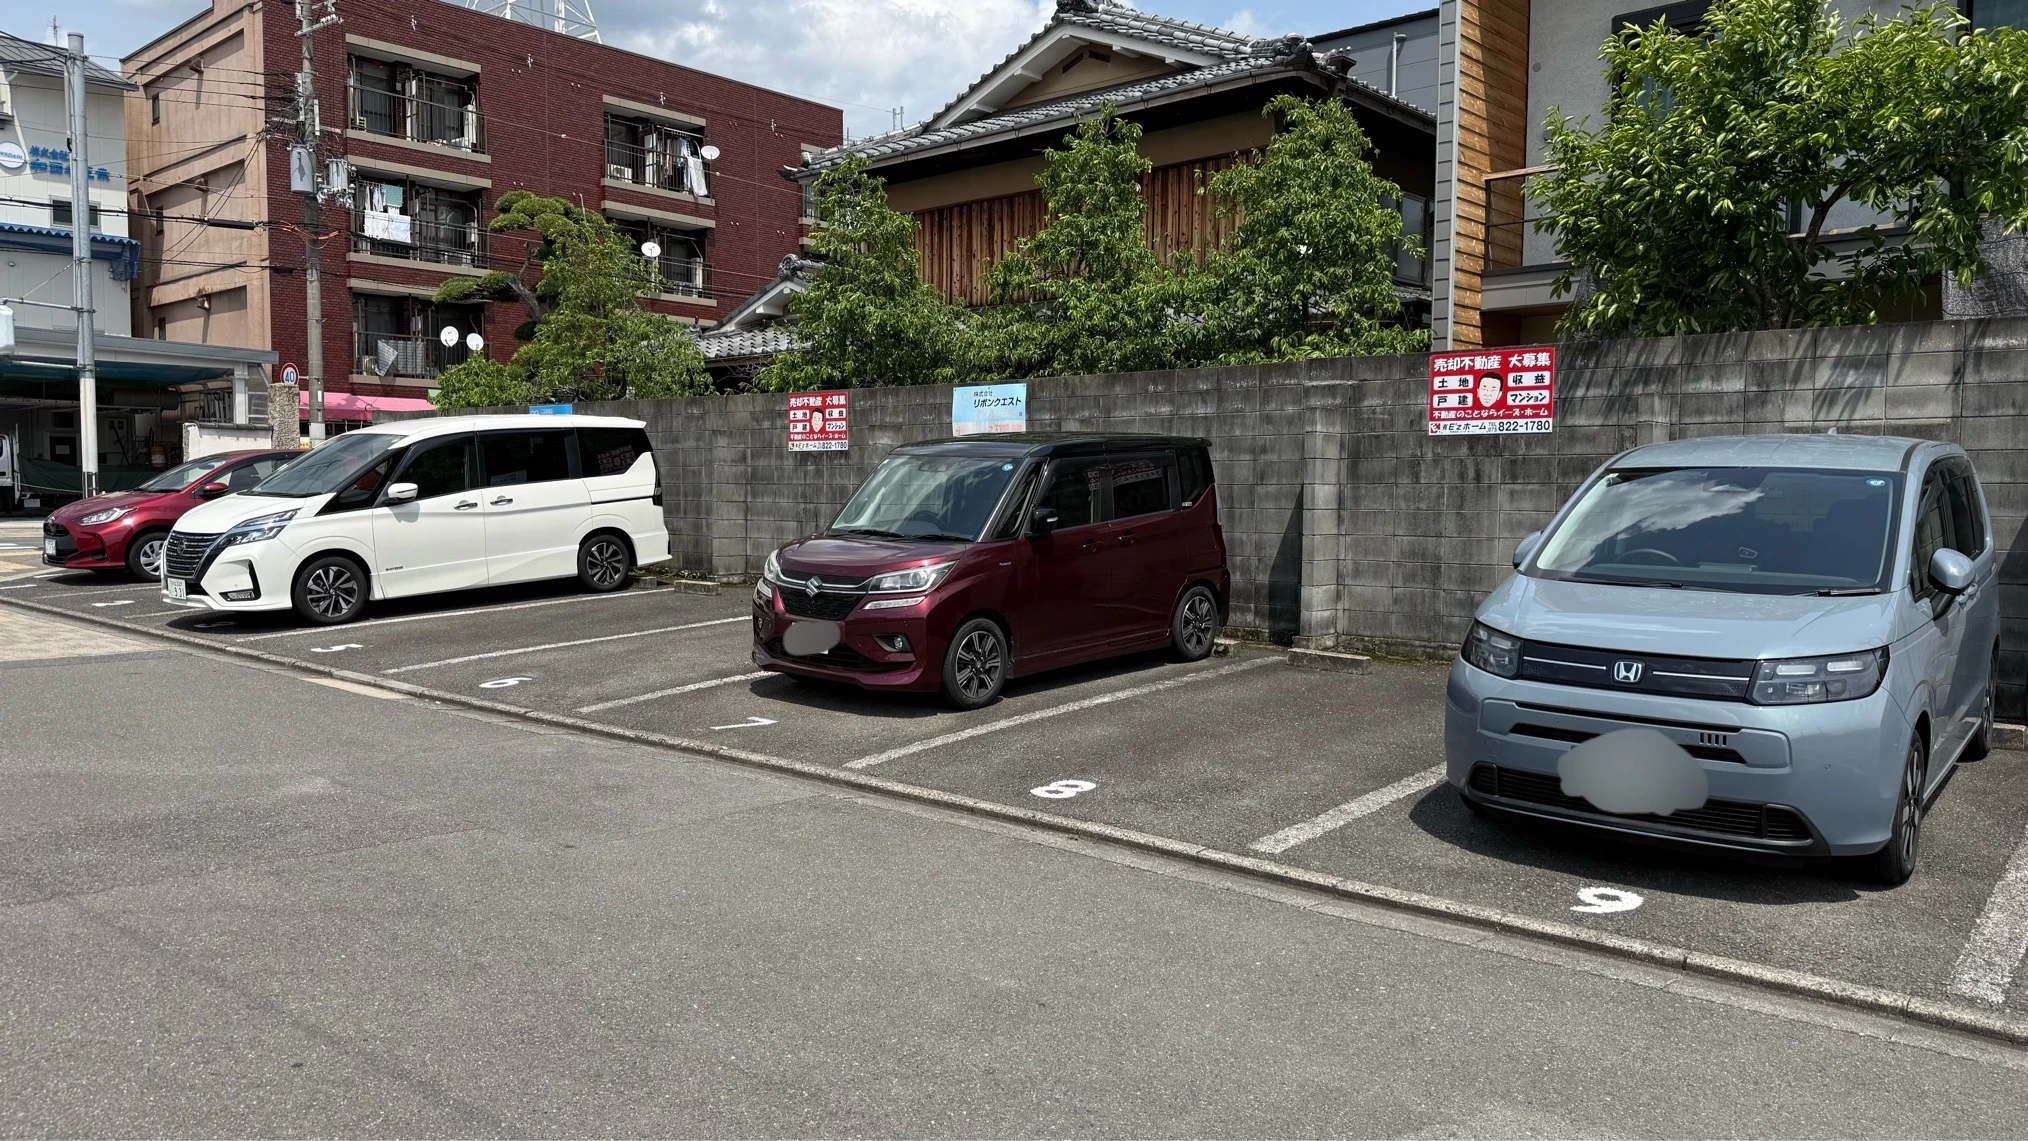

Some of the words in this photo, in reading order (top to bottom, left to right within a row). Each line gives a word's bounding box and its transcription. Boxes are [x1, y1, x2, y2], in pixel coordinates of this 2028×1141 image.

[1433, 355, 1501, 372] 売却不動産
[1508, 352, 1551, 368] 大募集
[285, 371, 294, 382] 40
[1437, 377, 1469, 388] 土地
[1512, 373, 1545, 385] 収益
[1437, 395, 1468, 406] 戸建
[1510, 392, 1546, 403] マンション
[1498, 420, 1550, 432] 822-1780
[310, 644, 364, 652] 5
[478, 676, 532, 688] 6
[710, 716, 779, 730] 7
[1030, 780, 1096, 798] 8
[1570, 887, 1644, 914] 9
